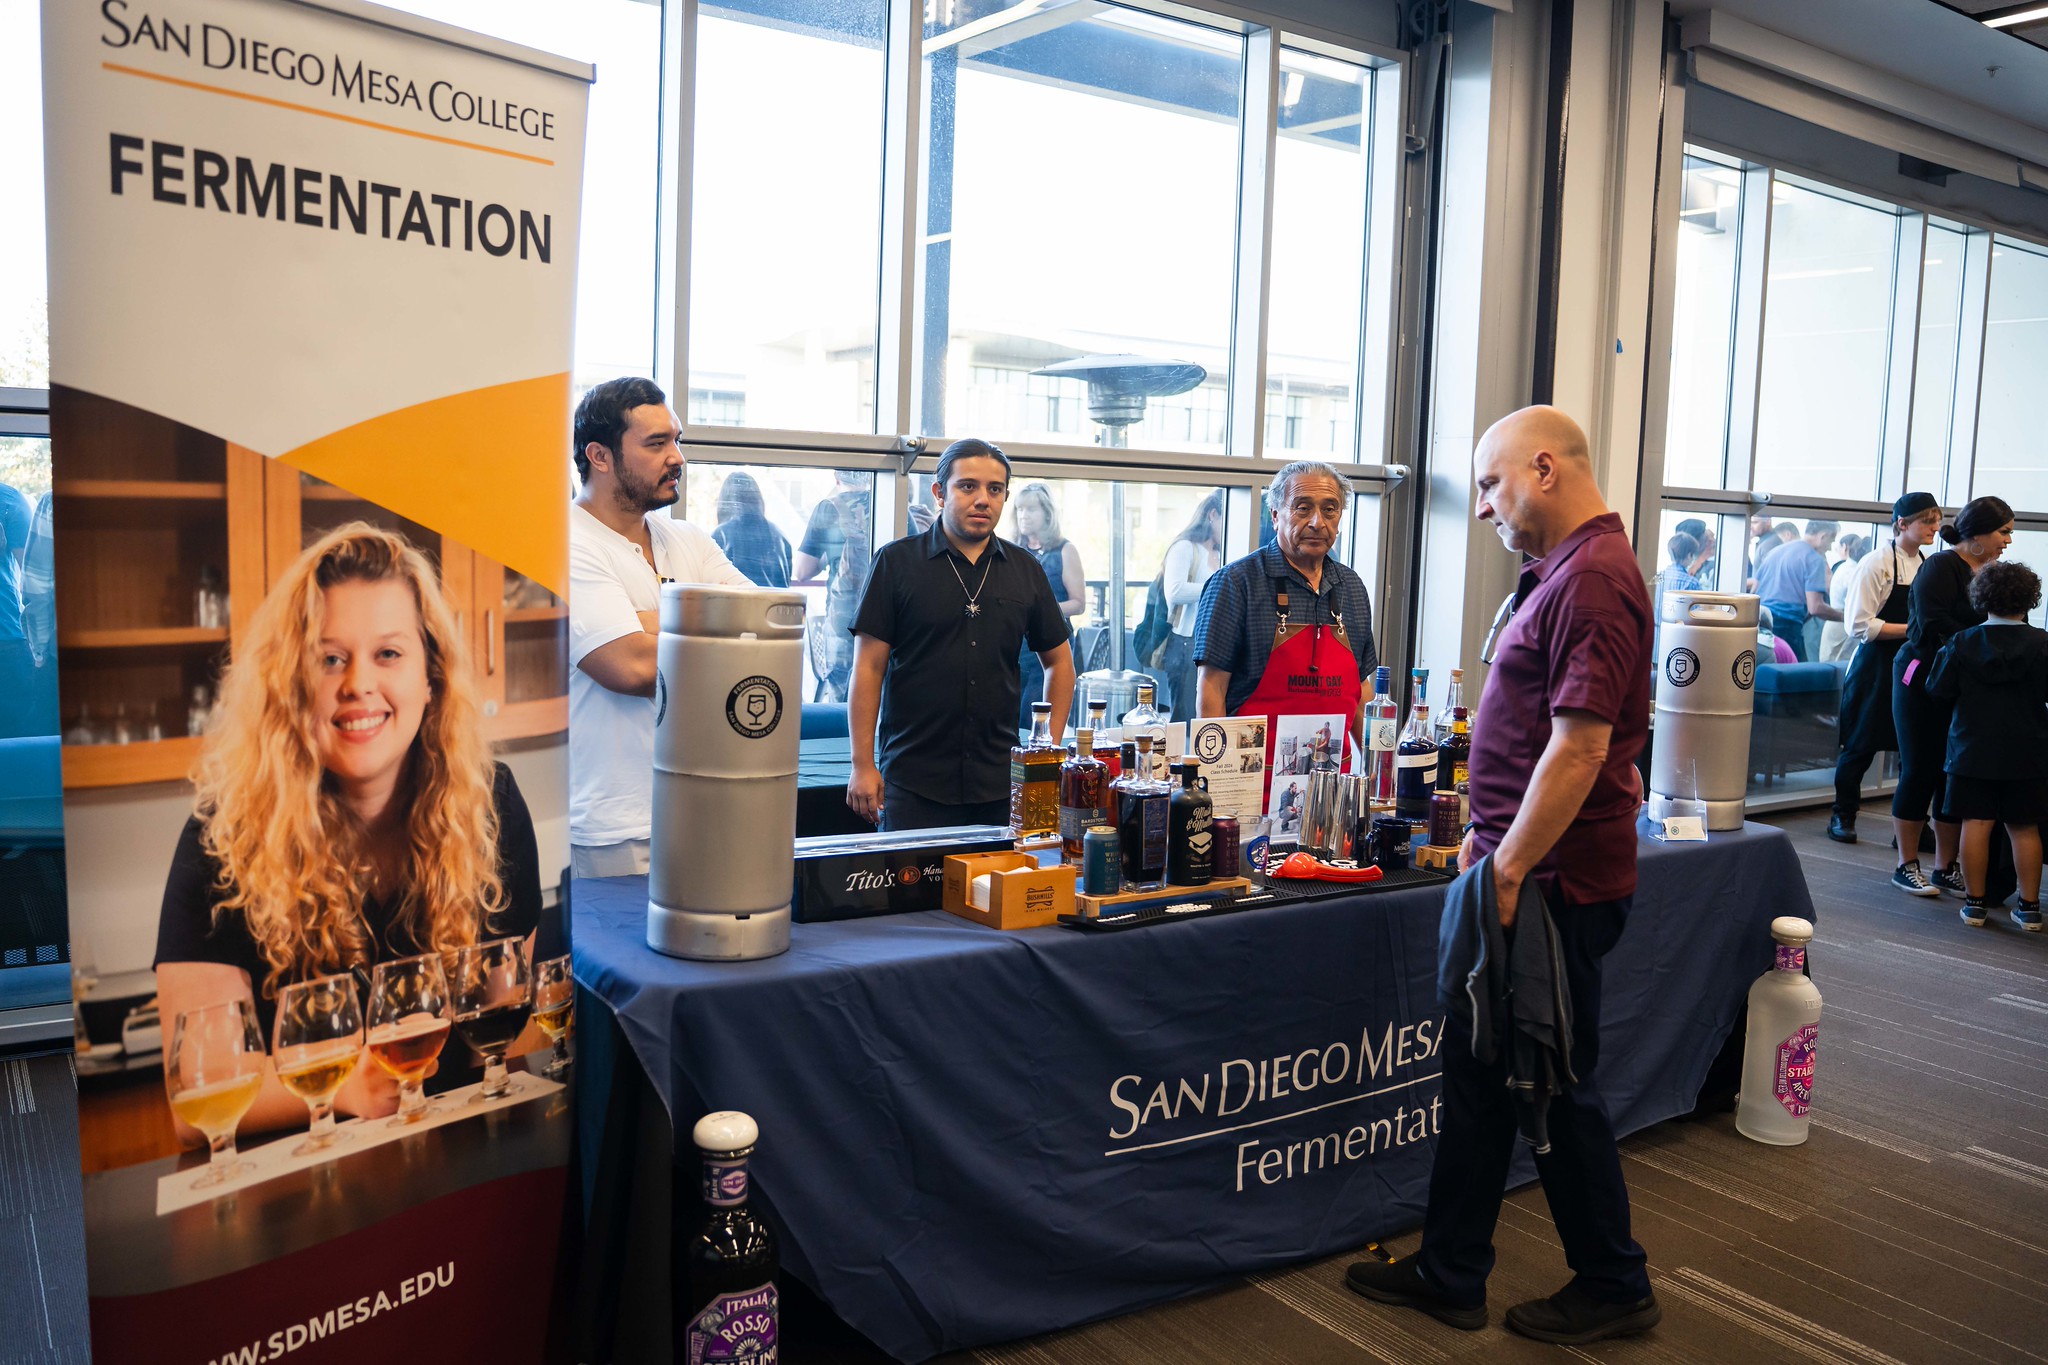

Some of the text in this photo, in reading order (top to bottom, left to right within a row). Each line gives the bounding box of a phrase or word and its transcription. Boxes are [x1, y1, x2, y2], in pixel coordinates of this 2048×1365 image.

[101, 0, 555, 142] SAN DIEGO MESA COLLEGE
[109, 131, 552, 265] FERMENTATION
[733, 677, 779, 695] FERMENTATION
[1288, 675, 1342, 687] MOUNT GAY
[846, 869, 895, 891] Tito's
[1026, 892, 1054, 901] BUSHMILLS
[1109, 1074, 1209, 1140] SAN
[1217, 1041, 1351, 1117] DIEGO
[207, 1262, 456, 1365] W.SDMESA.EDU
[726, 1292, 769, 1316] ITALIA
[720, 1314, 770, 1344] ROSSO
